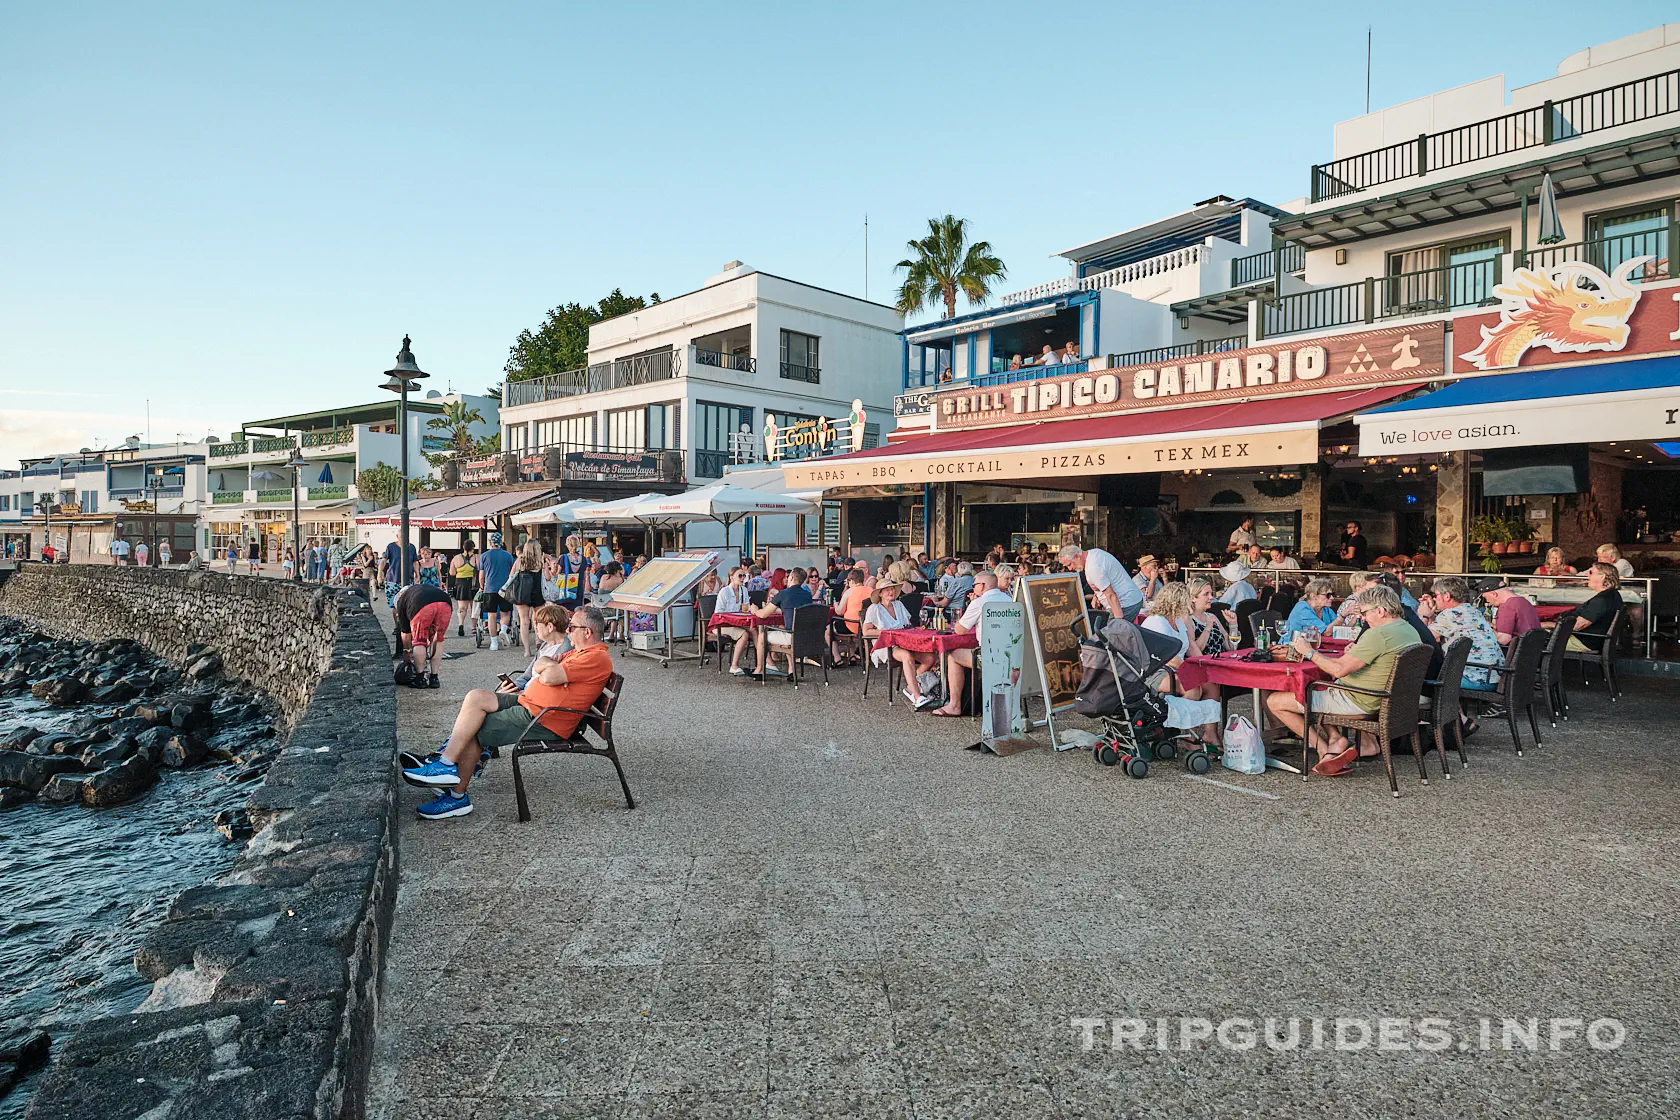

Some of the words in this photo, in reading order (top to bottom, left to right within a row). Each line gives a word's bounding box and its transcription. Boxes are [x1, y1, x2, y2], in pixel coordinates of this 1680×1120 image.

[942, 392, 1006, 415] GRILL
[1133, 345, 1328, 399] CANARIO
[904, 395, 918, 404] THE
[947, 409, 1006, 423] RESTAURANTE
[1380, 431, 1407, 444] We
[1412, 429, 1452, 443] love
[1458, 424, 1521, 439] asian.
[569, 461, 599, 472] Volcán
[600, 463, 610, 473] de
[611, 464, 655, 476] Timanfaya
[810, 470, 845, 481] TAPAS
[872, 466, 897, 478] BBQ
[927, 461, 1002, 475] COCKTAIL
[1041, 453, 1105, 468] PIZZAS
[1154, 448, 1193, 462] TEX
[1202, 443, 1249, 459] MEX
[986, 608, 1021, 618] Smoothies
